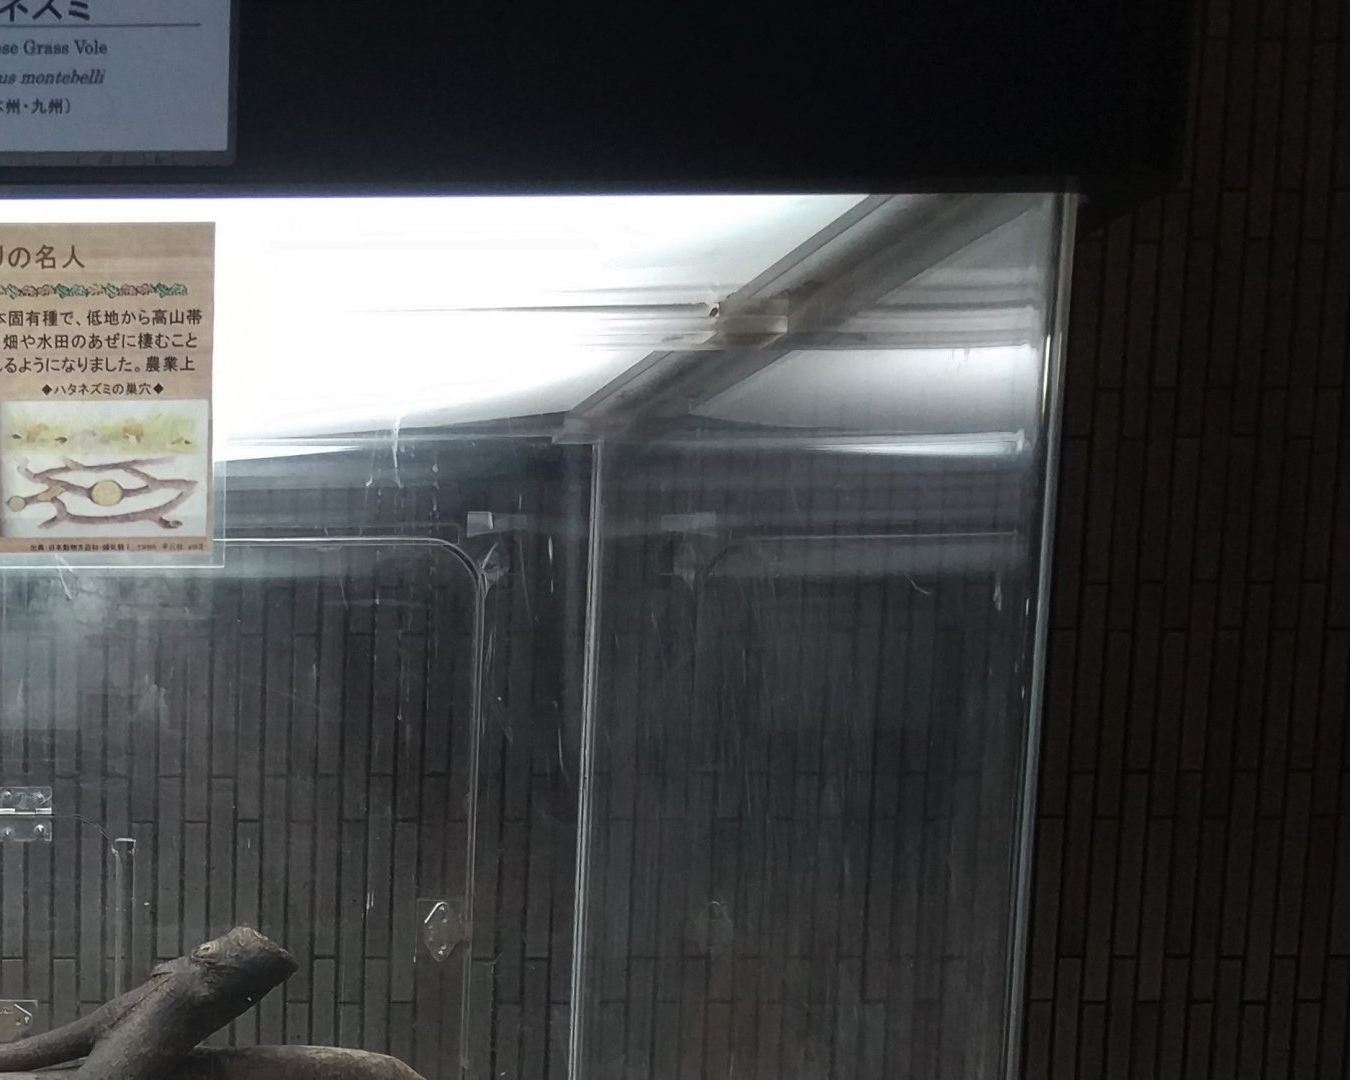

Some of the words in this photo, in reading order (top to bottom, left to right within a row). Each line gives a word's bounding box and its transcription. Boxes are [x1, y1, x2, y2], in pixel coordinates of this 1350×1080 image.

[23, 39, 70, 55] Grass
[74, 39, 108, 55] Vole
[20, 68, 106, 84] montebelli
